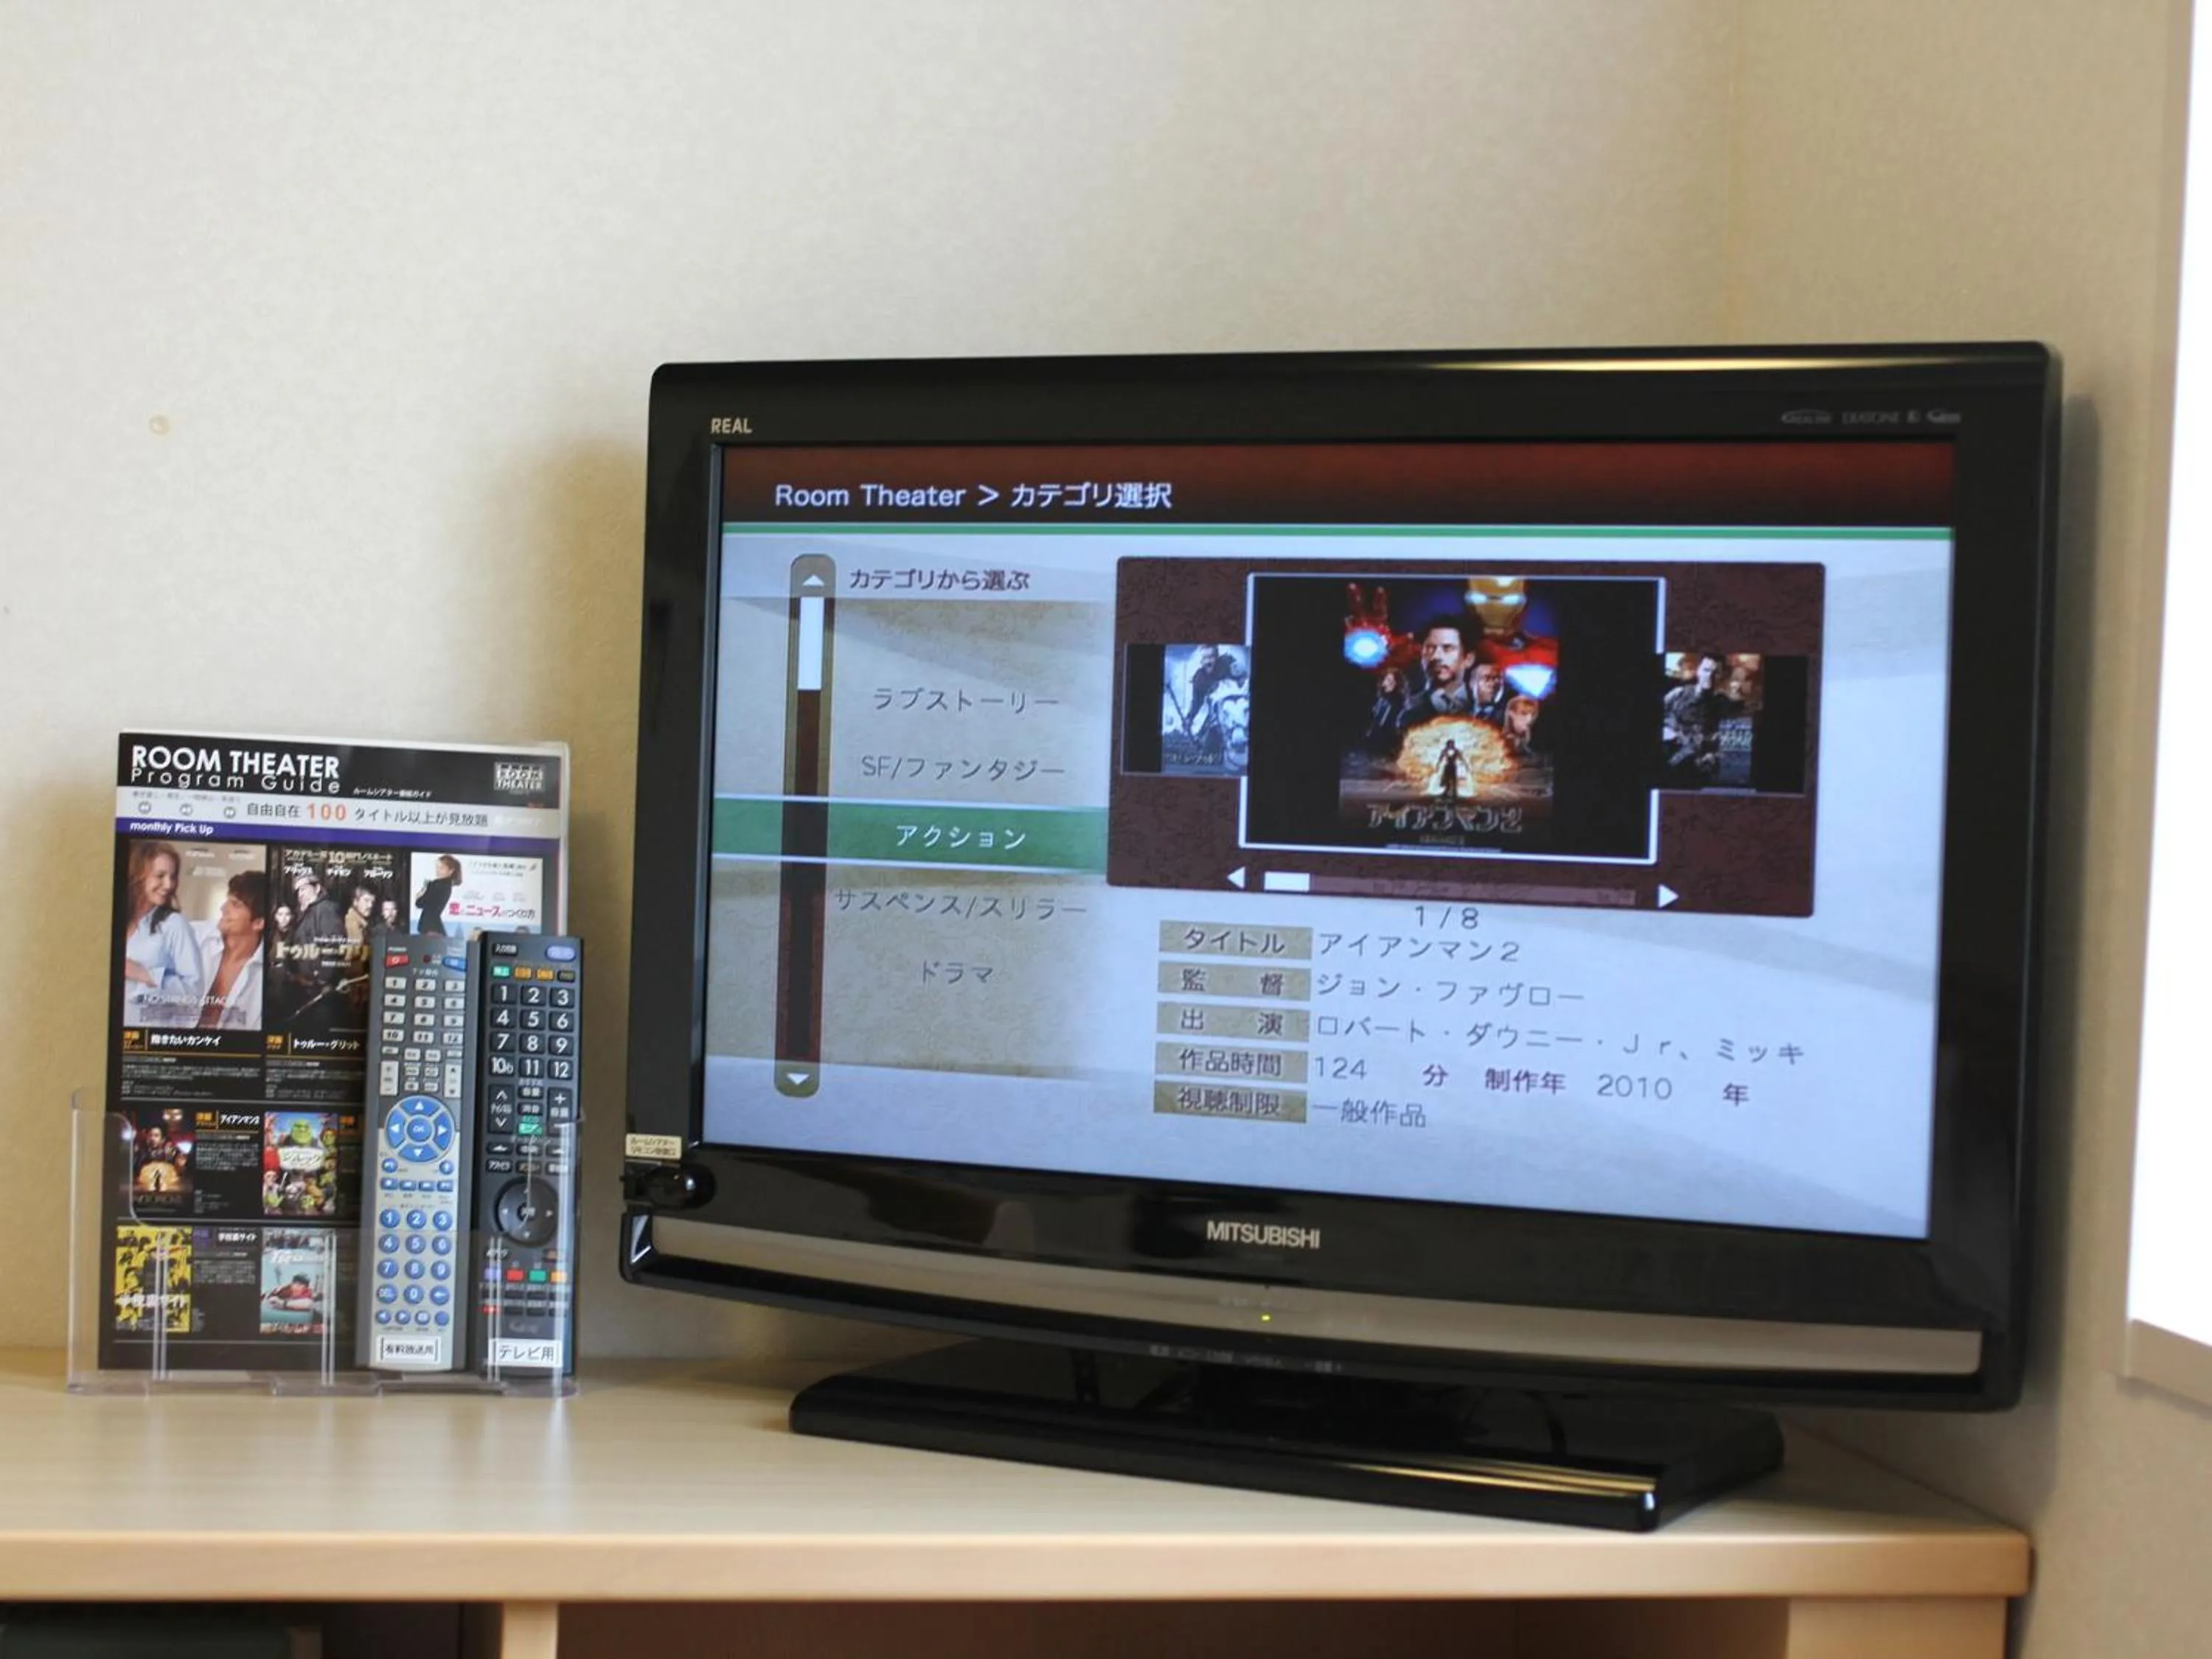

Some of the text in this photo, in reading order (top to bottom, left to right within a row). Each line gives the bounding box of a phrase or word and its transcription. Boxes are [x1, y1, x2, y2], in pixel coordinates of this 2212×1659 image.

[710, 416, 753, 434] REAL
[774, 483, 849, 507] Room
[860, 483, 966, 507] Theater
[1010, 481, 1173, 509] カテゴリ選択
[849, 568, 1031, 591] カテゴリから選ぶ
[874, 686, 1060, 714] ラブストーリー
[132, 745, 340, 779] ROOM THEATER
[860, 754, 1065, 782] SF/ファンタジー
[131, 767, 341, 795] Program Guide
[247, 801, 488, 828] 自由自在 100 タイトル以上が見放題
[130, 821, 214, 837] monthly Pick Up
[896, 824, 1026, 849] アクション
[834, 888, 1087, 920] サスペンス/スリラー
[1414, 905, 1480, 930] 1/8
[1183, 928, 1520, 962] タイトル アイアンマン2
[922, 959, 994, 985] ドラマ
[501, 985, 508, 1001] 1
[528, 987, 540, 1004] 2
[557, 990, 569, 1006] 3
[1316, 973, 1585, 1007] ジョン・ファヴロー
[496, 1009, 509, 1026] 4
[527, 1011, 539, 1027] 5
[557, 1012, 568, 1029] 6
[497, 1033, 509, 1050] 7
[526, 1035, 538, 1051] 8
[555, 1037, 568, 1054] 9
[526, 1059, 539, 1076] 11
[554, 1062, 569, 1079] 12
[1179, 1048, 1750, 1107] 作品時間 124 分 制作年 2010 年
[1178, 1087, 1427, 1129] 視聴制限 一般作品
[387, 1212, 394, 1224] 1
[412, 1214, 421, 1225] 2
[384, 1237, 392, 1248] 4
[411, 1237, 420, 1249] 5
[1206, 1220, 1321, 1249] MITSUBISHI
[384, 1262, 392, 1273] 7
[498, 1345, 555, 1361] テレビ用
